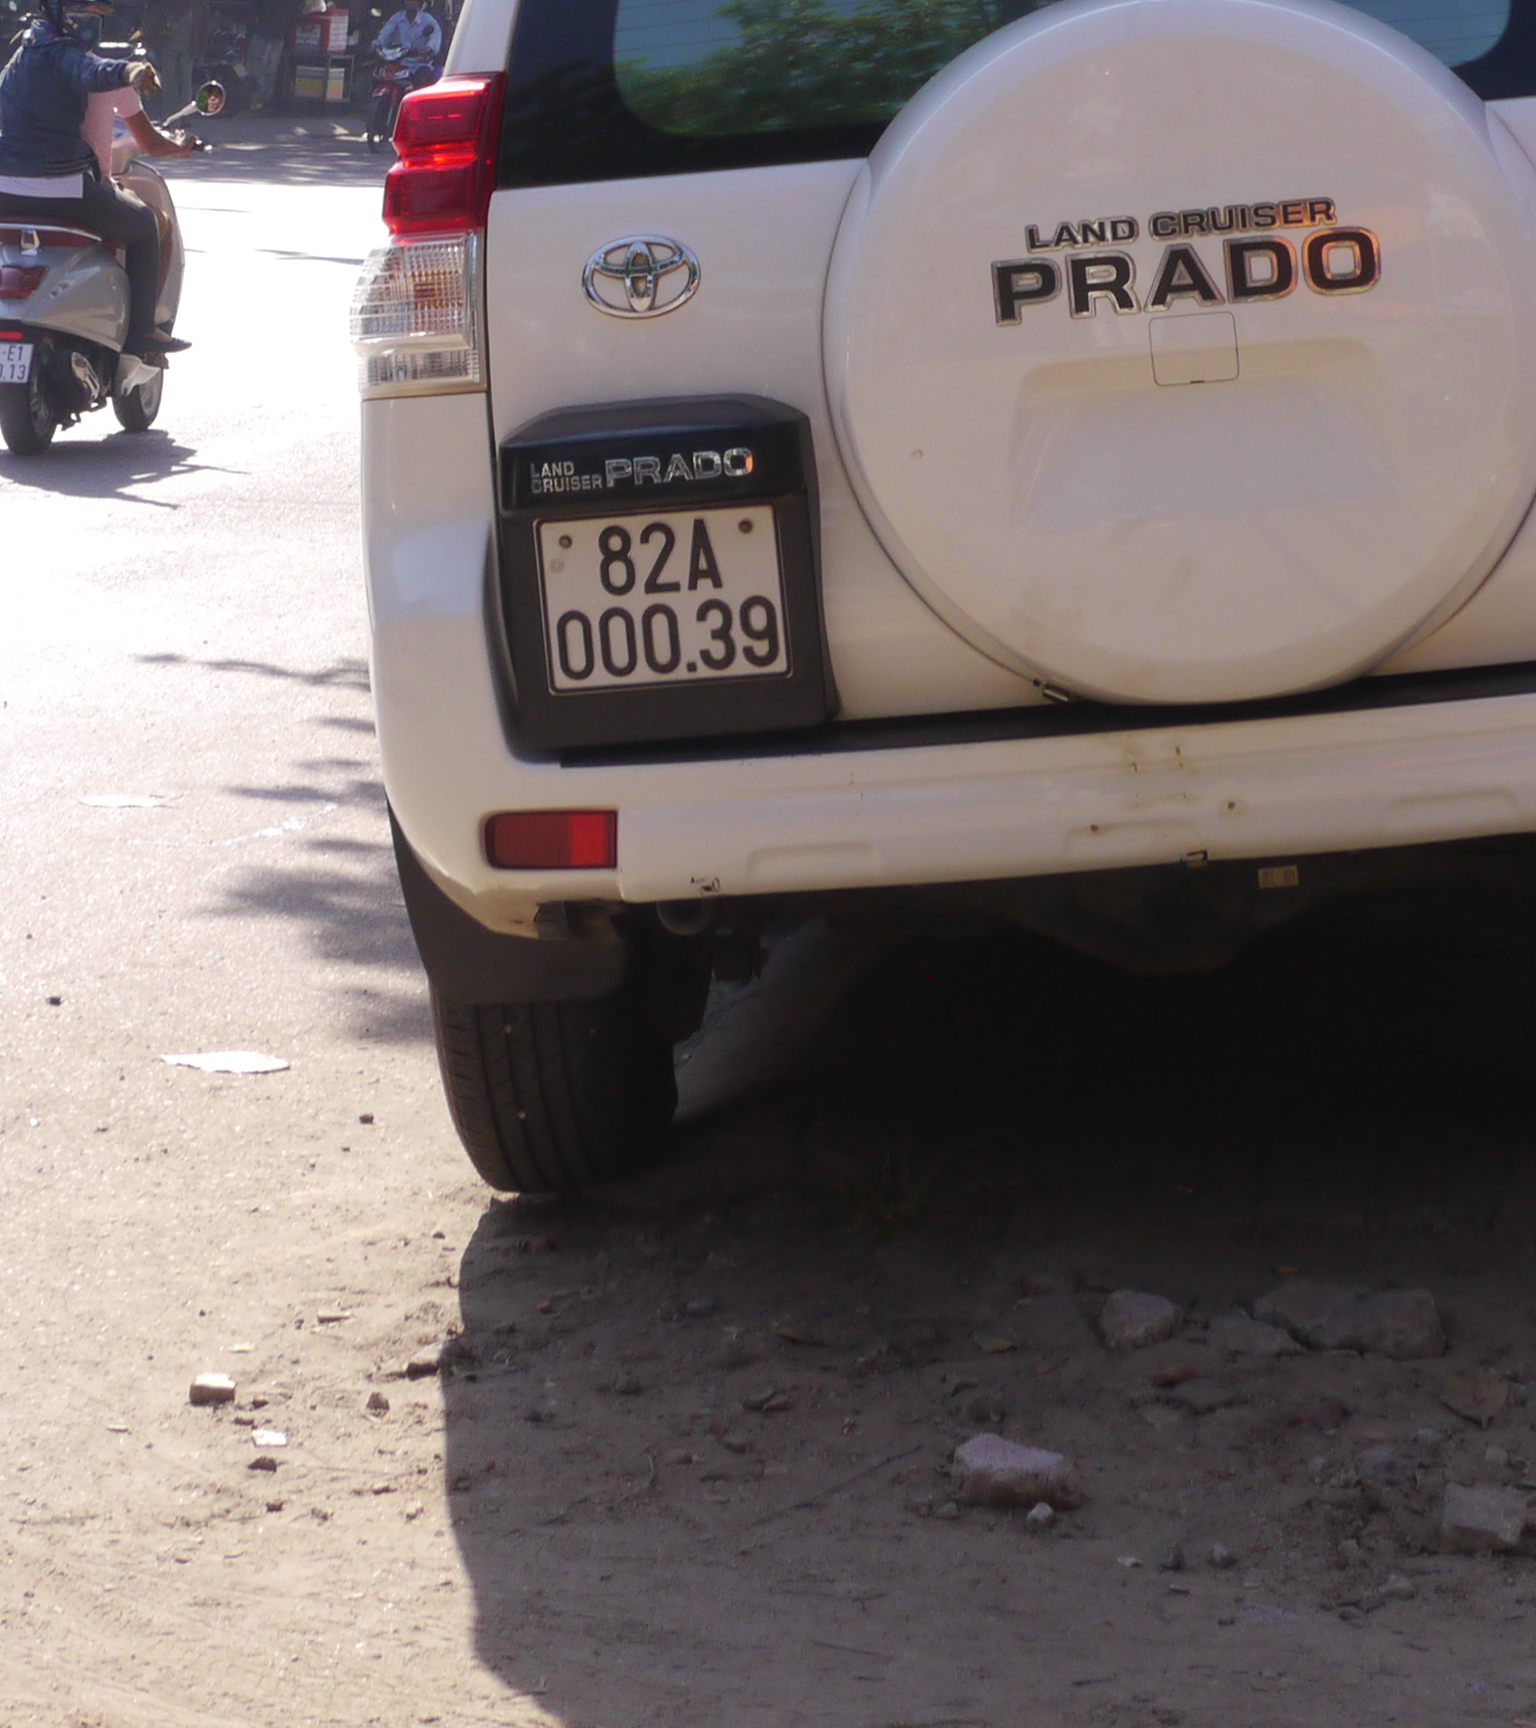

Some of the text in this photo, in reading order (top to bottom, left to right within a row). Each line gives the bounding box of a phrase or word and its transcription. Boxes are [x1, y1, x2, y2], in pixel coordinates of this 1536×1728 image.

[1025, 216, 1139, 254] LAND
[1148, 196, 1336, 241] CRUISER
[990, 225, 1382, 327] PRADO
[530, 447, 753, 488] LAND PRADO
[530, 475, 603, 494] CRUISER
[598, 518, 724, 596] 82A
[556, 595, 780, 681] 000.39
